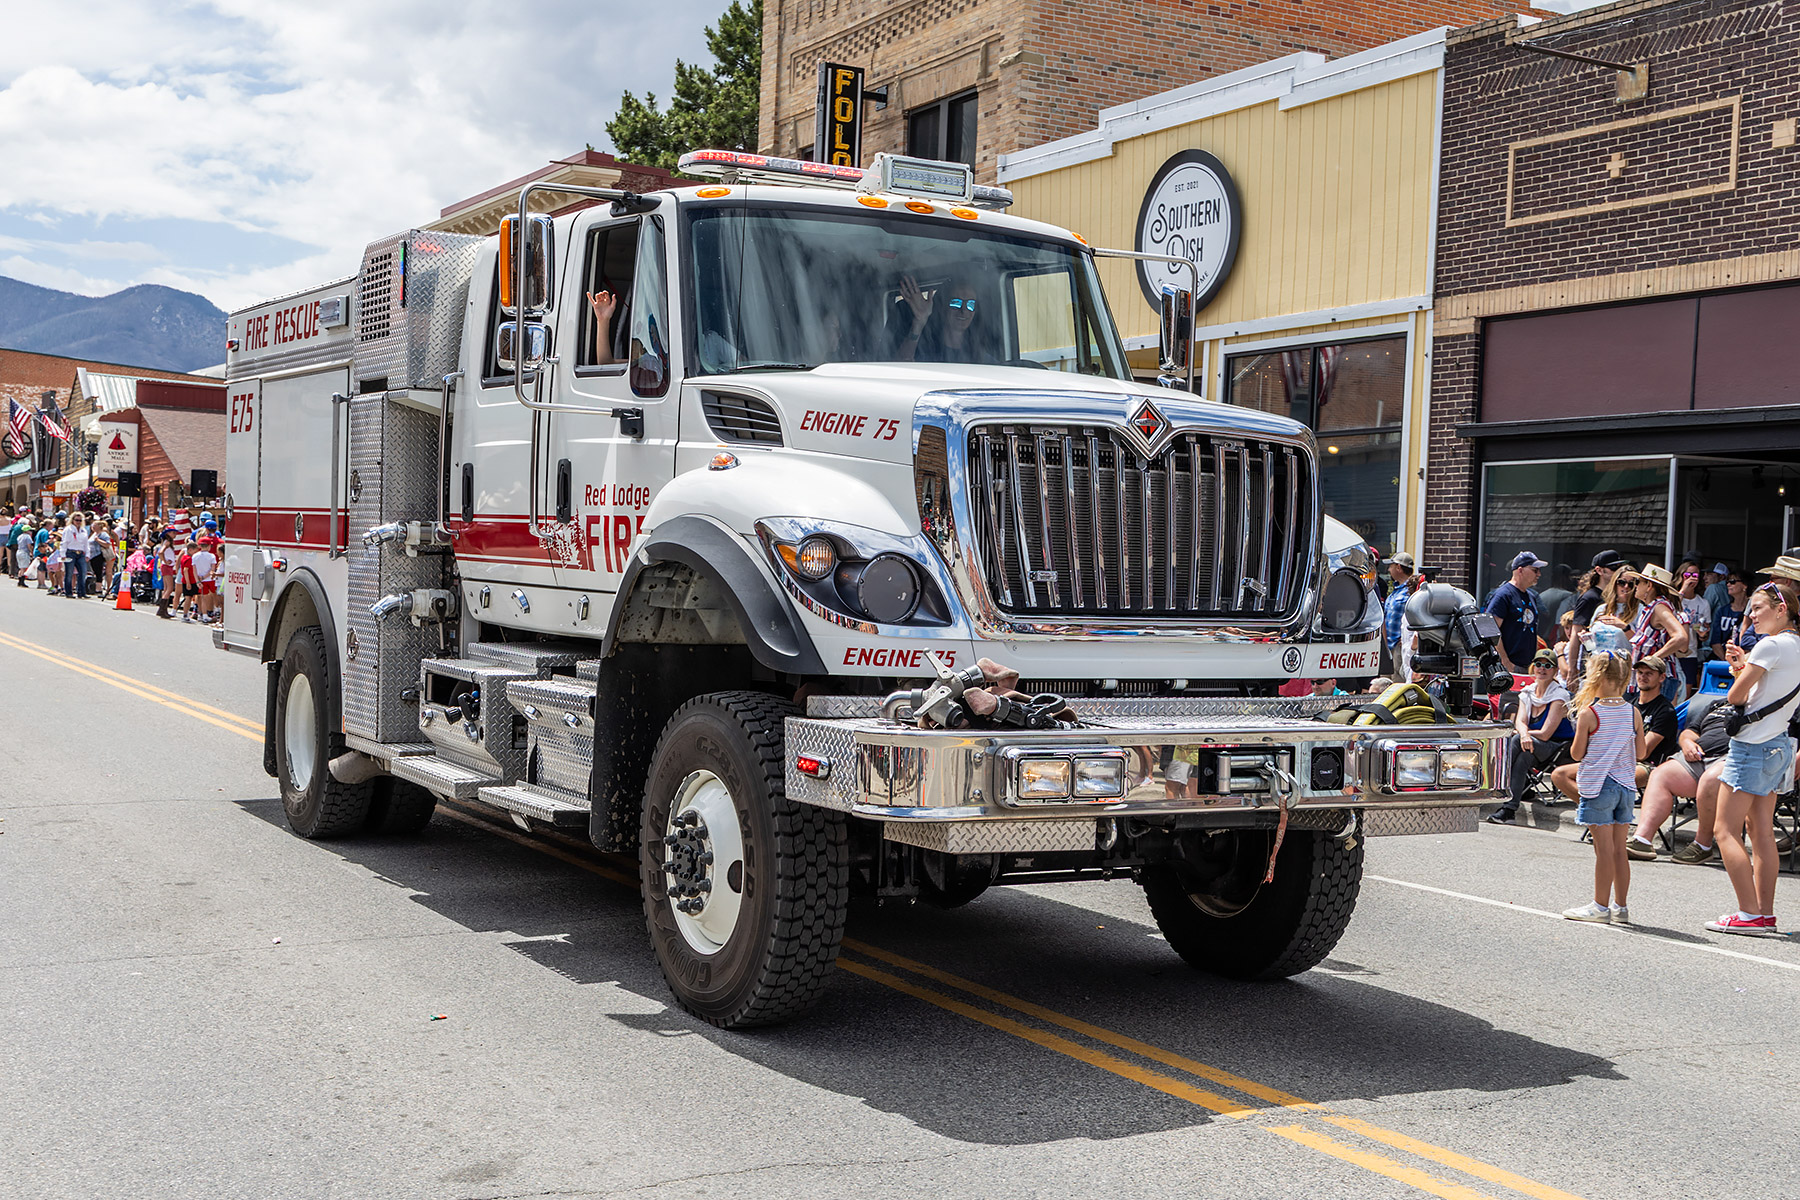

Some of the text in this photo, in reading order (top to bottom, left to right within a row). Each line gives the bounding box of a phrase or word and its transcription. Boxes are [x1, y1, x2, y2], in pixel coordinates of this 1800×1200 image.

[1187, 180, 1199, 190] 2021
[1150, 198, 1220, 244] SOUTHERN
[245, 300, 320, 351] FIRE RESCUE
[231, 393, 254, 433] E75
[799, 409, 901, 440] ENGINE 75
[585, 483, 650, 511] Red Lodge
[228, 571, 251, 585] EMERGENCY
[235, 586, 244, 604] 911
[1721, 616, 1740, 632] US
[842, 647, 924, 668] ENGINE
[1319, 651, 1379, 669] ENGINE 75
[647, 804, 712, 989] GOODYEAR
